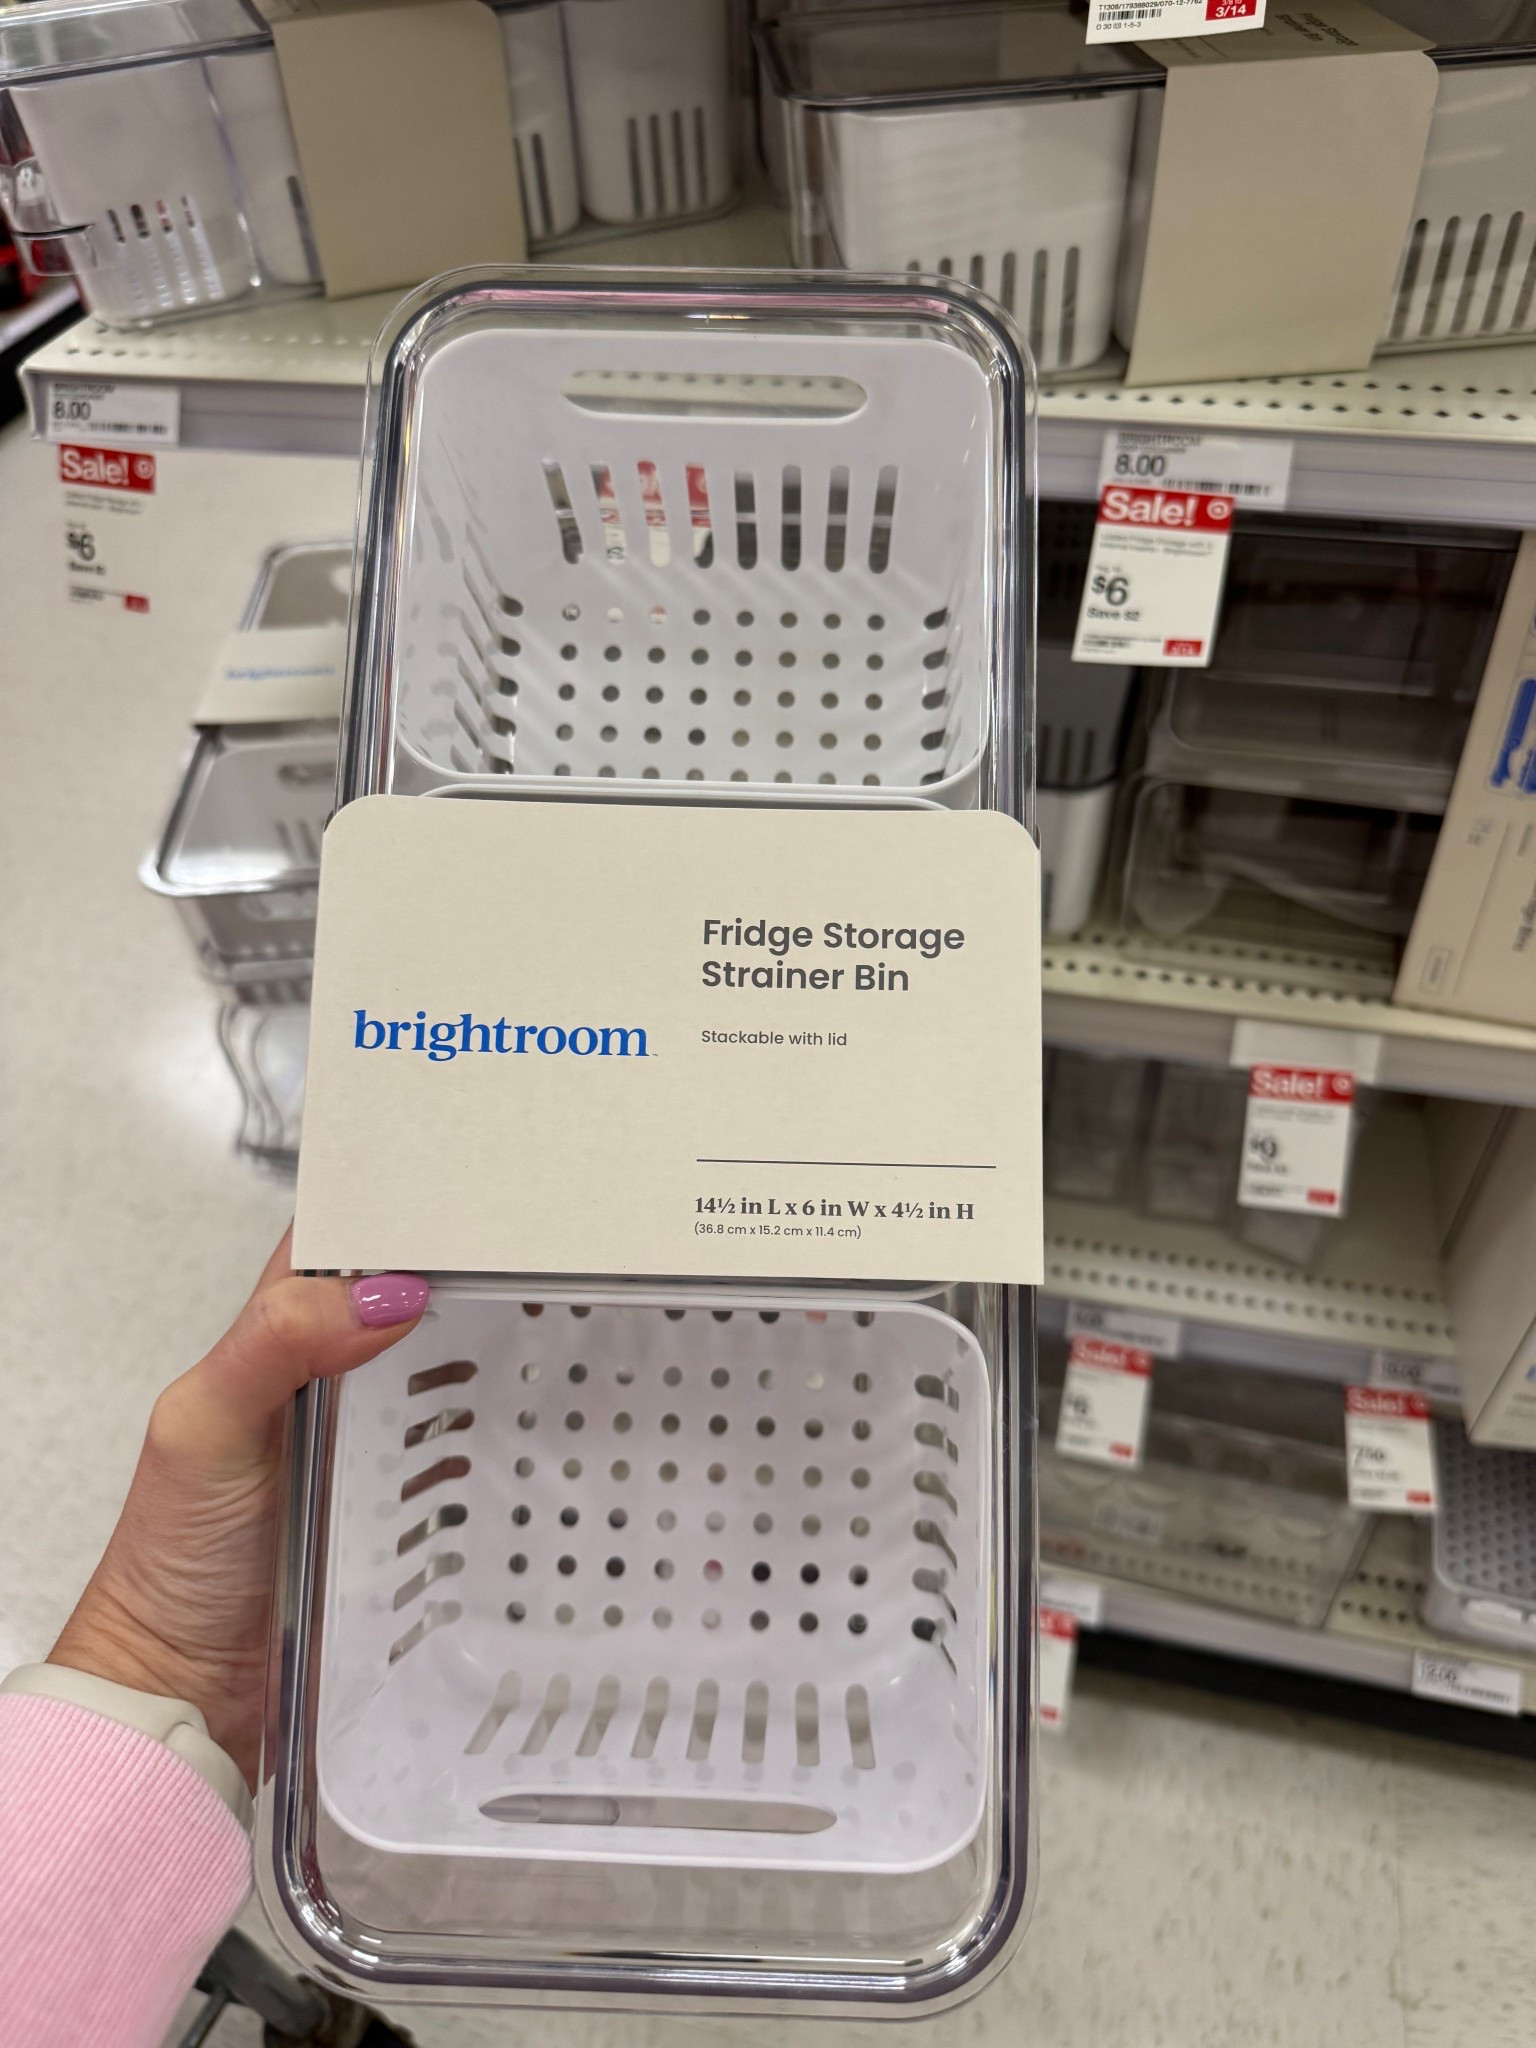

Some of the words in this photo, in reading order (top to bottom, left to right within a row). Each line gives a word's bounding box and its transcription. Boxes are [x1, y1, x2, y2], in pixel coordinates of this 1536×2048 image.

[1215, 5, 1247, 18] 3/14
[53, 401, 92, 421] 8.00
[62, 449, 130, 486] Sale!
[1115, 453, 1167, 477] 8.00
[1101, 488, 1199, 527] Sale!
[1091, 575, 1130, 606] $6
[1087, 607, 1121, 620] Save
[703, 917, 813, 956] Fridge
[823, 922, 965, 959] Storage
[702, 960, 845, 990] Strainer
[855, 962, 909, 991] Bin
[352, 1009, 651, 1062] brightroom
[701, 1030, 784, 1045] Stackable
[788, 1031, 823, 1046] with
[828, 1032, 848, 1046] lid
[695, 1197, 736, 1214] 14½
[740, 1197, 763, 1215] in
[767, 1198, 781, 1215] L
[785, 1203, 798, 1216] x
[802, 1199, 815, 1216] 6
[820, 1199, 842, 1217] in
[847, 1200, 870, 1218] W
[874, 1204, 887, 1218] x
[891, 1202, 924, 1219] 4½
[928, 1201, 951, 1219] in
[956, 1203, 975, 1220] H
[694, 1221, 724, 1236] (36.8
[727, 1225, 747, 1235] cm
[749, 1226, 756, 1235] x
[758, 1224, 781, 1236] 15.2
[783, 1226, 803, 1236] cm
[806, 1227, 813, 1236] x
[815, 1226, 835, 1237] 11.4
[837, 1225, 862, 1240] cm)
